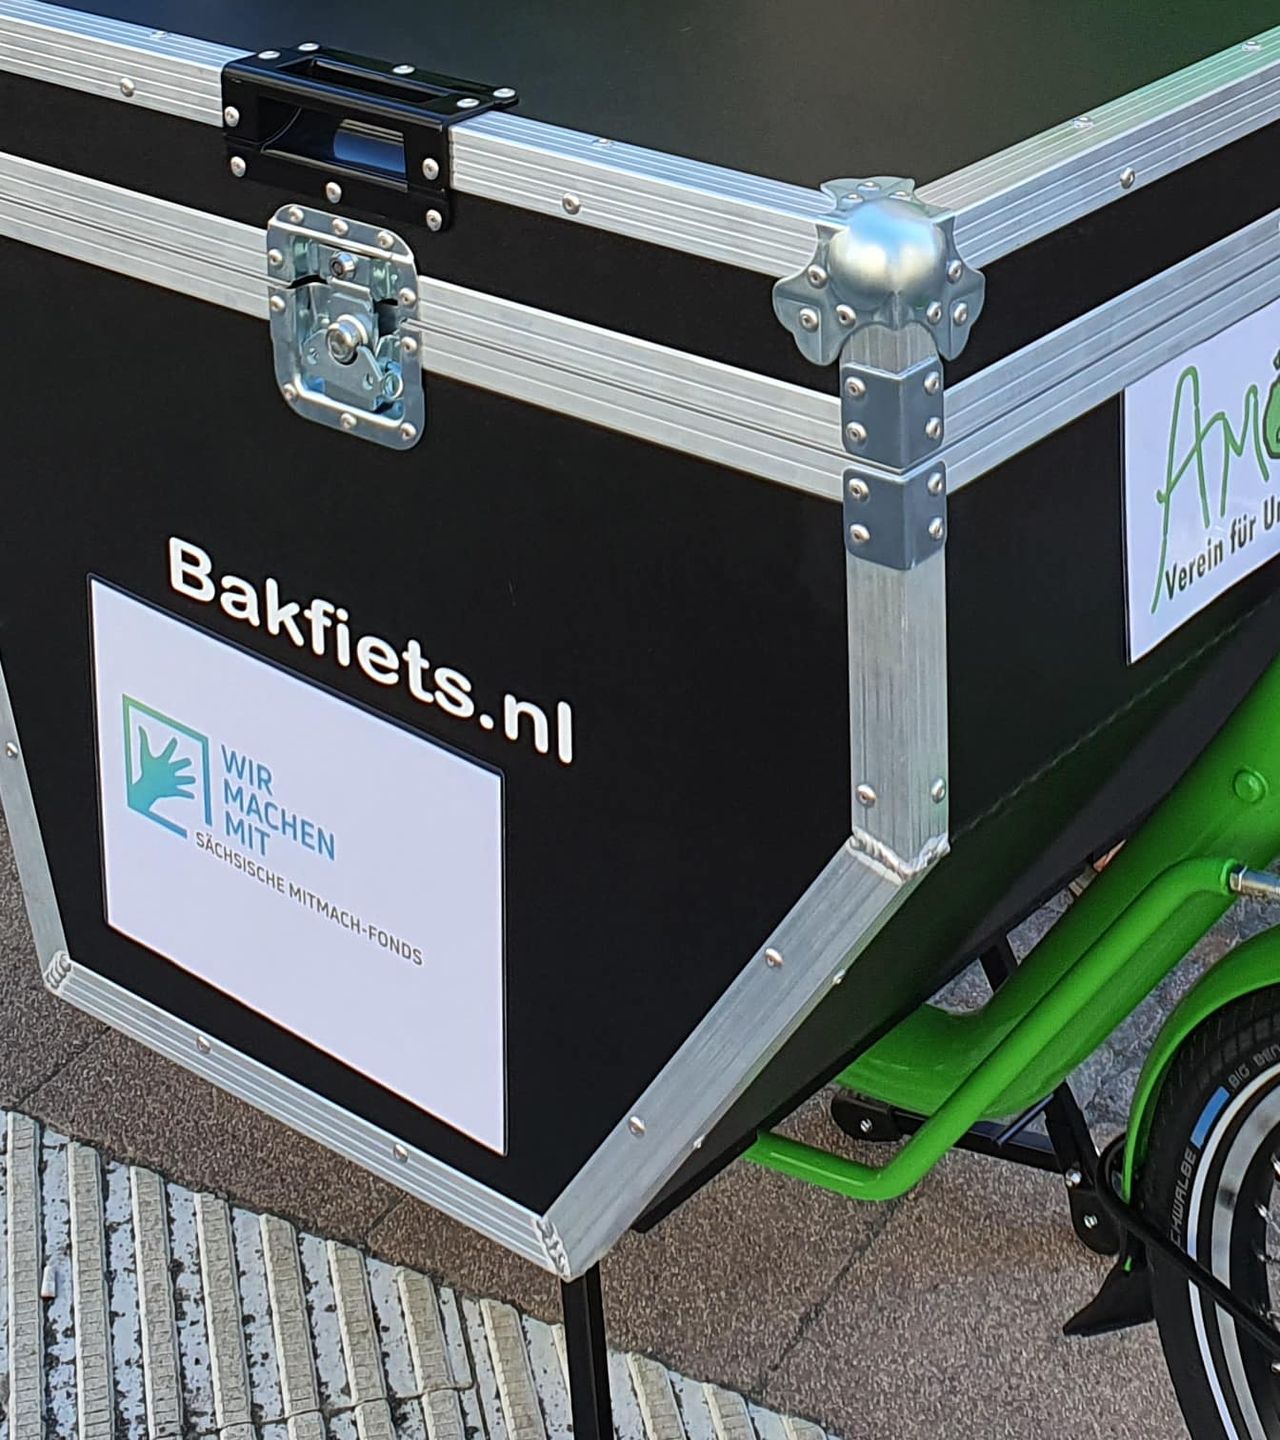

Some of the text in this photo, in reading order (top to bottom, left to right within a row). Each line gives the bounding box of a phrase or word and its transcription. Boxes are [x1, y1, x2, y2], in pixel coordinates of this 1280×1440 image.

[1164, 538, 1224, 601] Verein
[1229, 515, 1257, 555] für
[168, 536, 574, 765] Bakfiets.nl
[220, 743, 274, 797] WIR
[222, 777, 337, 861] MACHEN
[224, 811, 272, 857] MIT
[195, 831, 424, 967] SÄCHSISCHE MITMACH-FONDS
[1227, 1063, 1251, 1090] BIG
